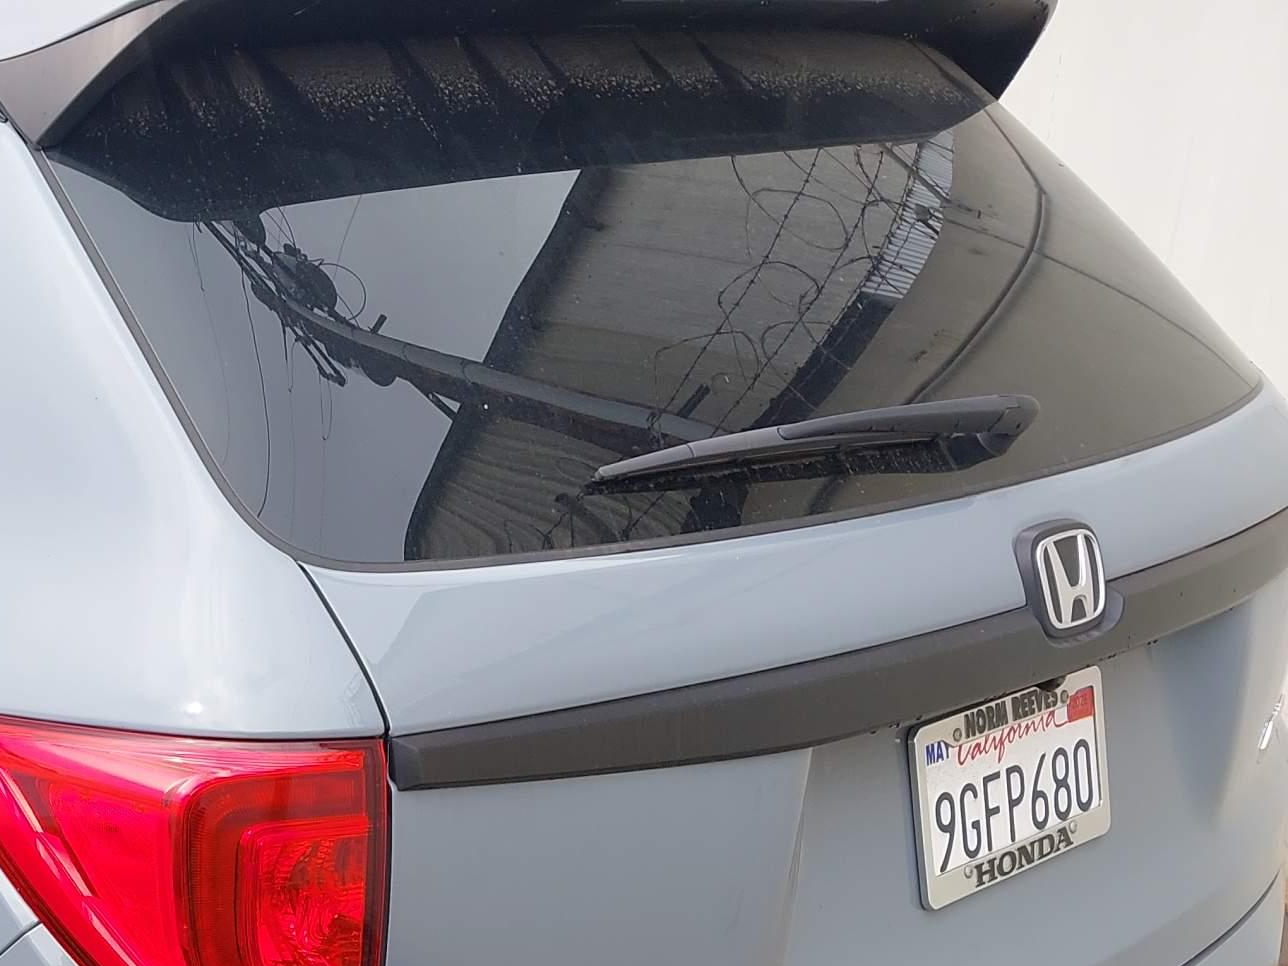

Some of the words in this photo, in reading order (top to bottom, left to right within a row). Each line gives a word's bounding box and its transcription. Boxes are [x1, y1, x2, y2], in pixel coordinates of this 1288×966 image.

[957, 709, 1069, 766] California
[963, 700, 1009, 740] NORM
[1011, 689, 1058, 722] REEVES
[925, 740, 950, 767] MAY
[934, 738, 1094, 874] 9GFP680
[974, 826, 1075, 888] HONDA
